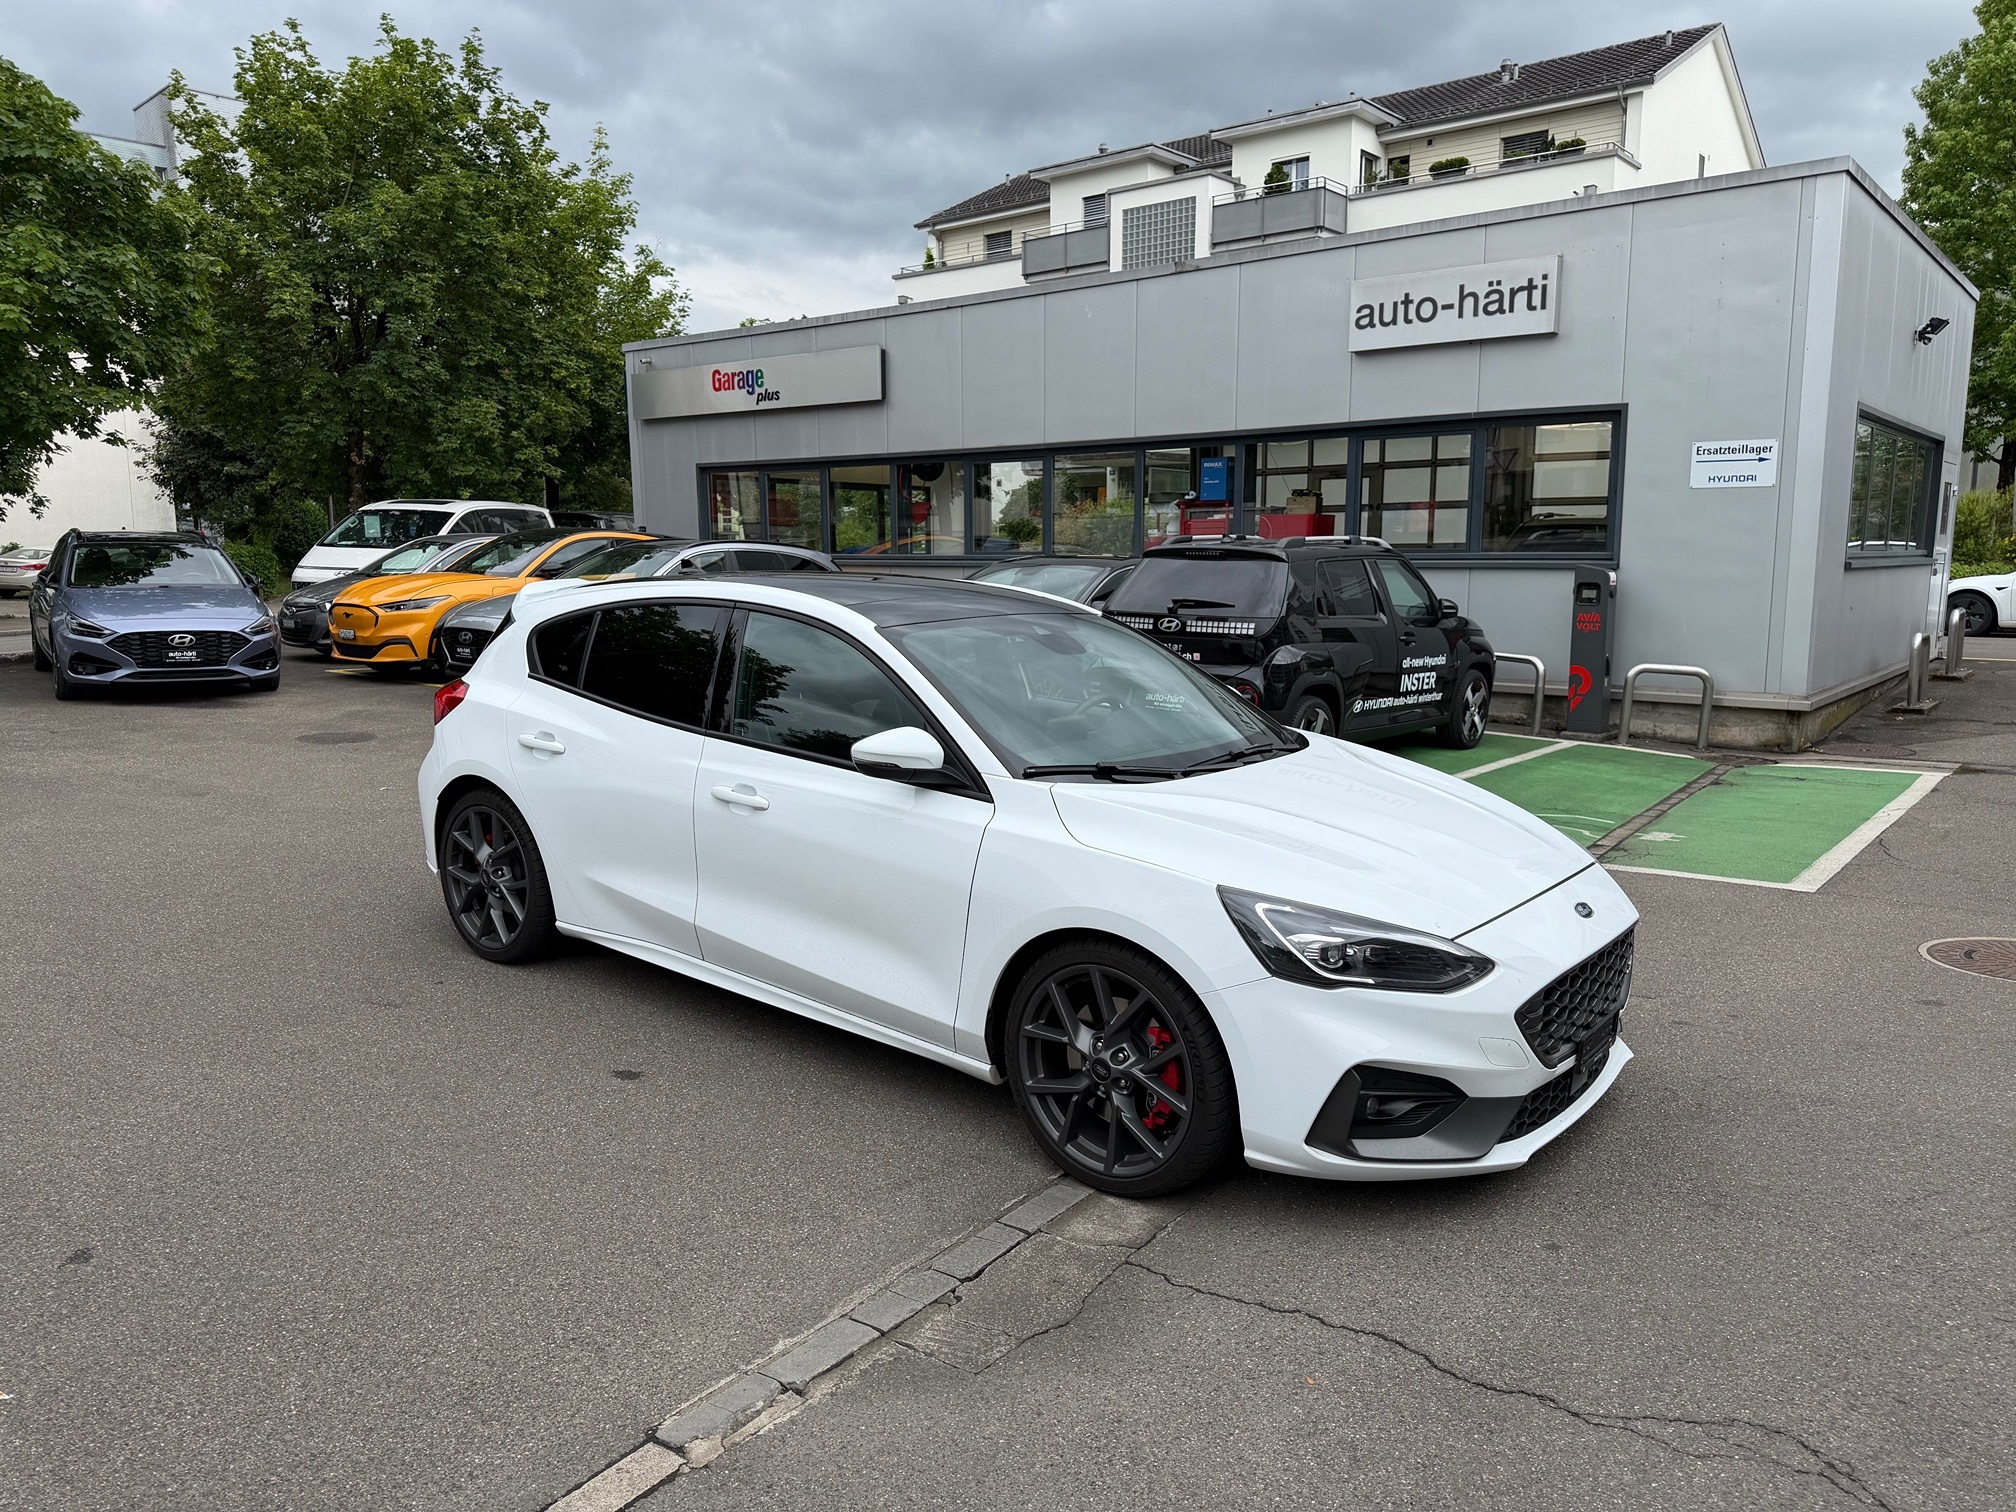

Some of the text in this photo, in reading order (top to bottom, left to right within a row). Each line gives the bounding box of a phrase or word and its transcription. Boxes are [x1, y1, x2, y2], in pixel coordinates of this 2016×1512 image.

[1355, 273, 1549, 330] auto-härti
[712, 368, 765, 396] Garage
[756, 387, 781, 406] plus
[1696, 444, 1774, 456] Ersatzteillager
[1708, 474, 1758, 483] HYUNDAI
[1576, 612, 1602, 622] AVIA
[1576, 622, 1601, 633] VOLT
[1402, 653, 1447, 669] all-new Hyundai
[1400, 671, 1437, 692] INSTER
[1363, 696, 1394, 711] HYUNDAI
